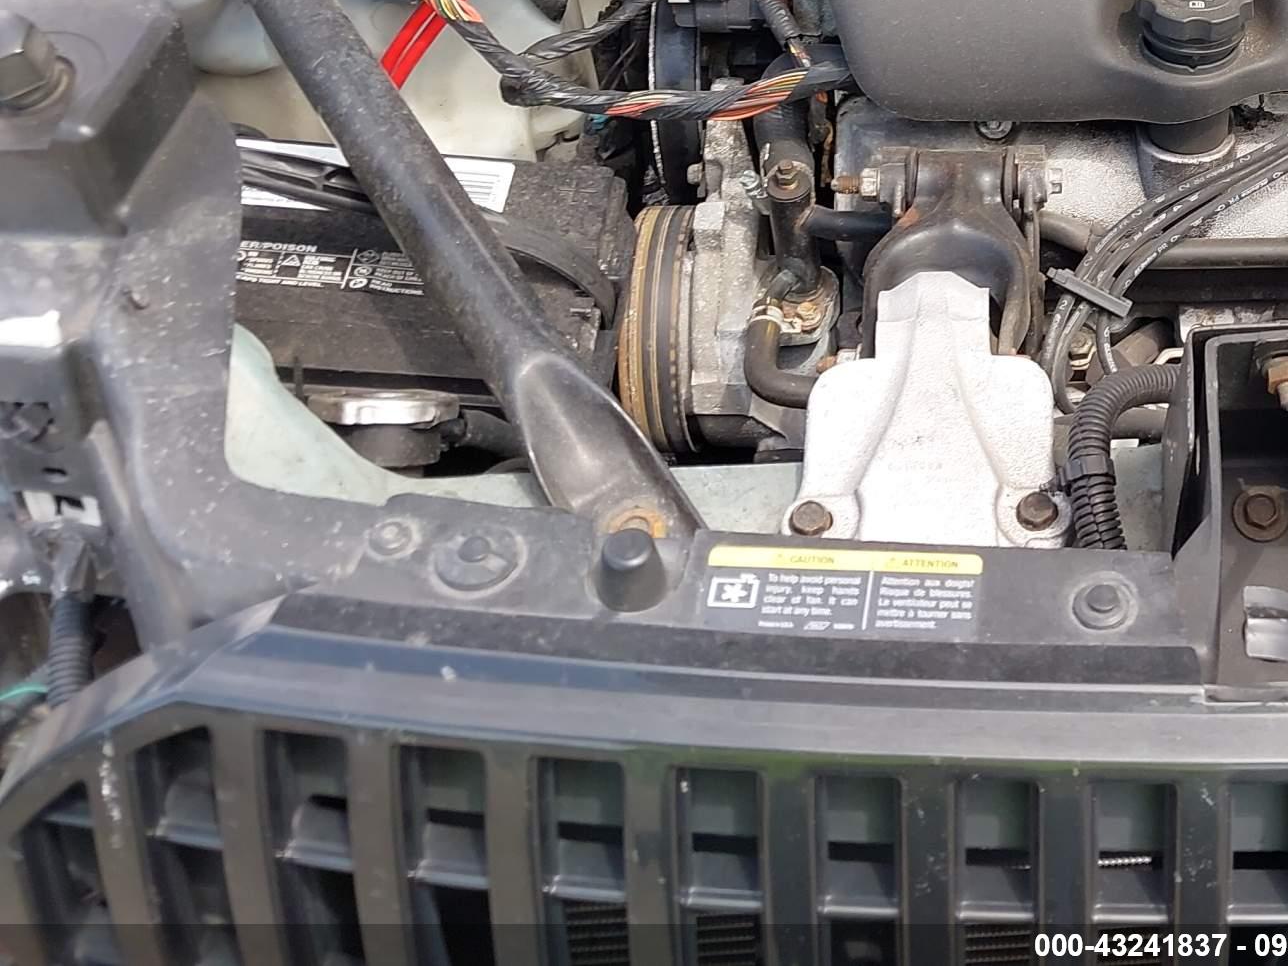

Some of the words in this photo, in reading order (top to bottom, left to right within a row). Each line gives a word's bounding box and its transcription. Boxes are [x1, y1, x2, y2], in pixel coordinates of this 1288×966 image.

[239, 239, 318, 253] ER/POISON
[790, 555, 835, 564] CAUTION
[902, 558, 959, 568] ATTENTION
[780, 574, 799, 585] help
[800, 575, 823, 584] avoid
[824, 576, 861, 586] personal
[881, 576, 921, 587] Attention
[801, 586, 824, 596] keep
[832, 586, 860, 596] hands
[763, 595, 786, 604] clear
[790, 596, 801, 605] of
[840, 597, 858, 606] can
[793, 607, 810, 617] any
